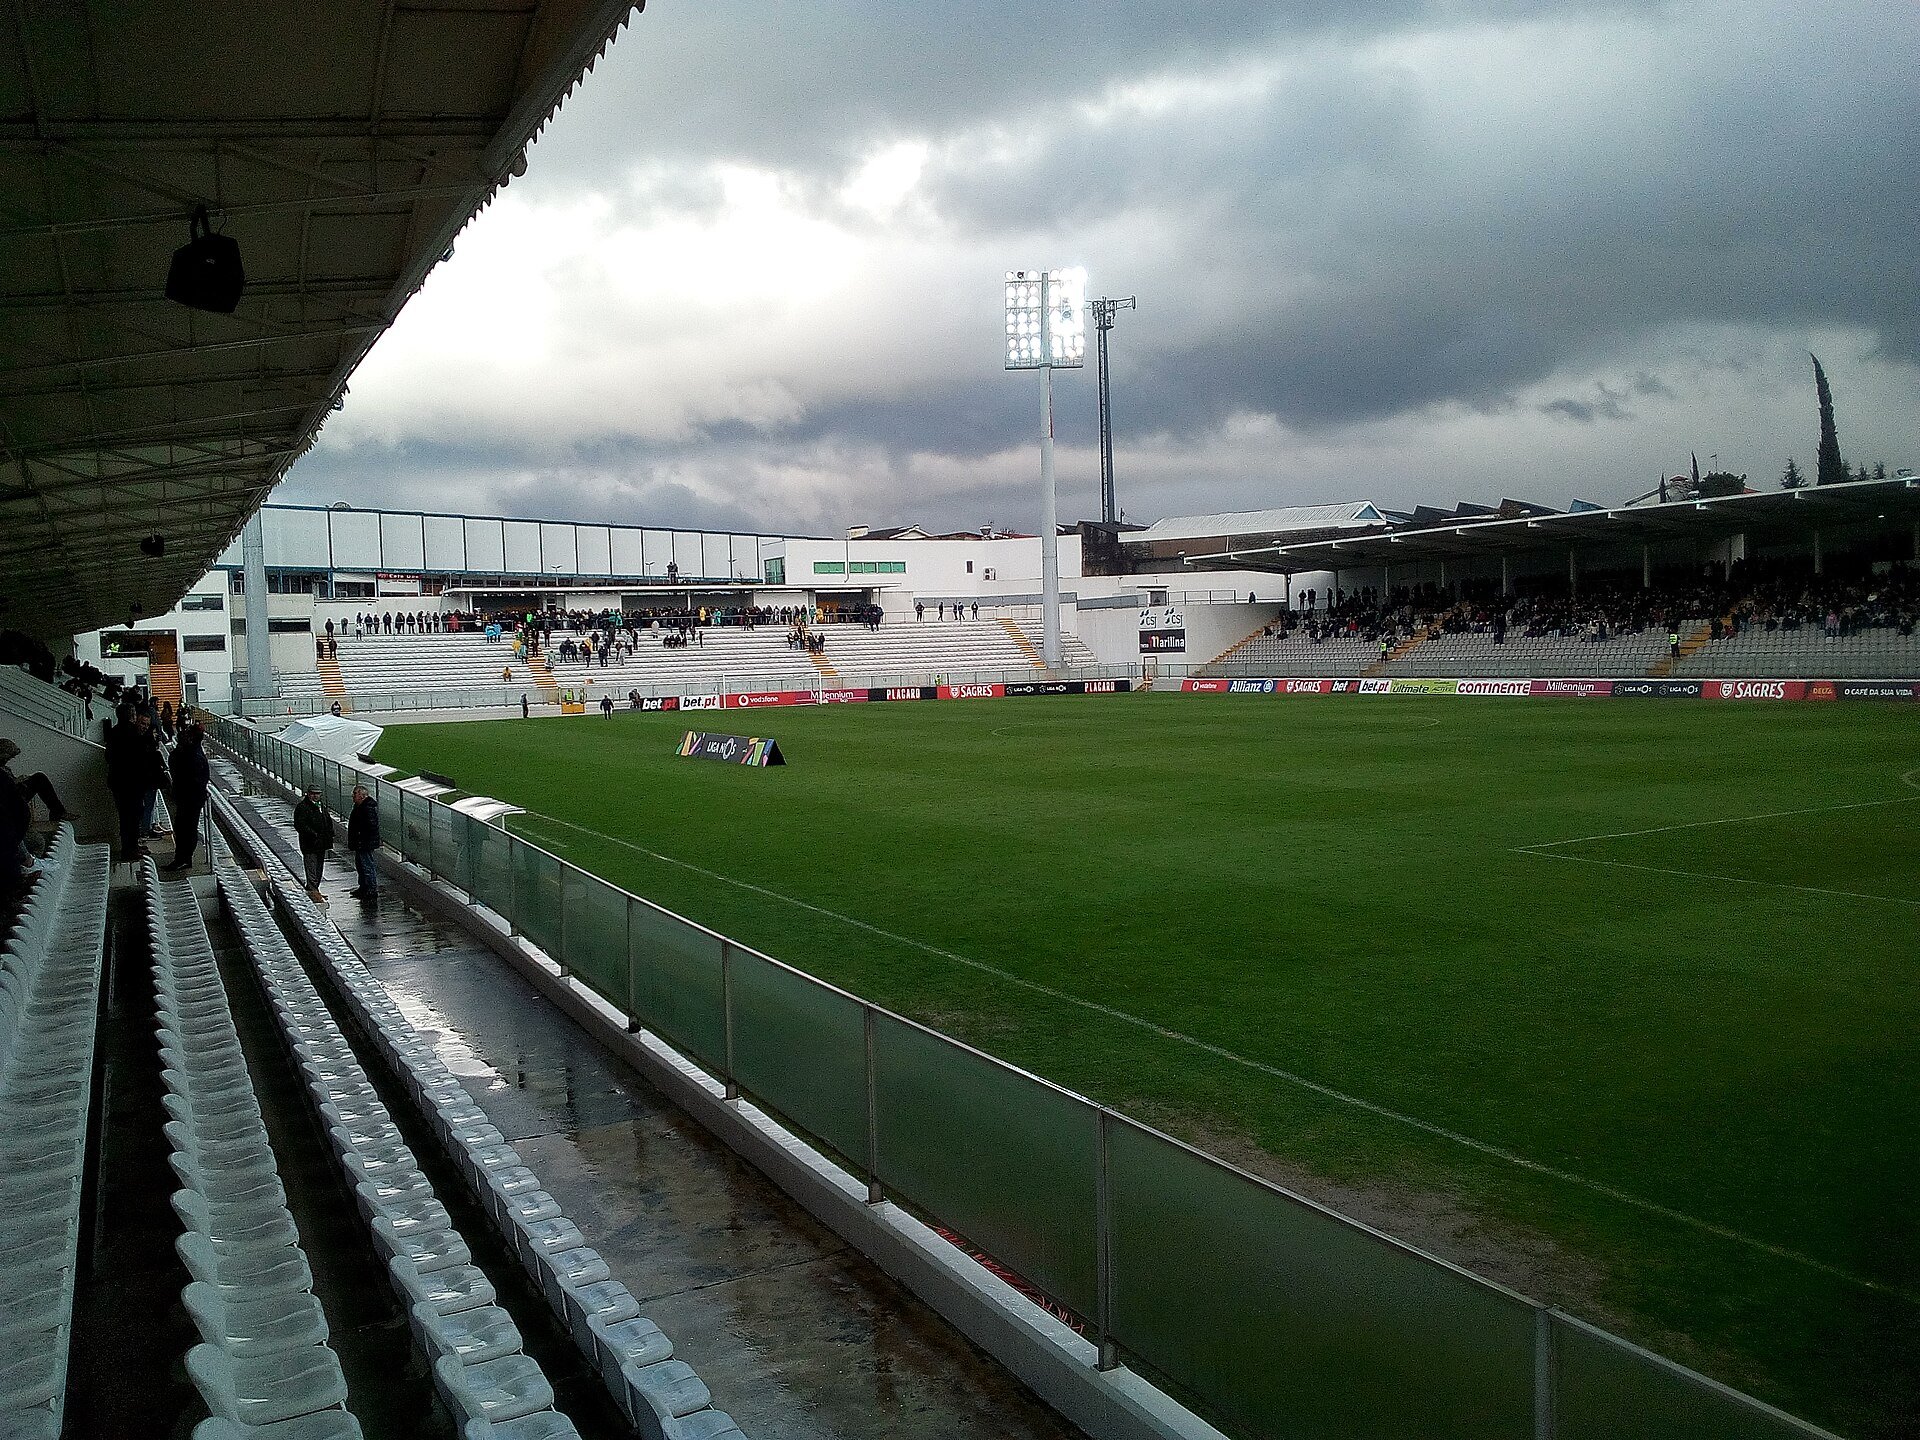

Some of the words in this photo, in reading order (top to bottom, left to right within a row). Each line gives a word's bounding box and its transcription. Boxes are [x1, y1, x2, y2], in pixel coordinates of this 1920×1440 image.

[960, 685, 993, 697] SAGRES
[1230, 680, 1262, 693] Allianz
[1294, 680, 1322, 693] SAGRES
[1361, 680, 1390, 694] bet.pt
[1393, 684, 1430, 694] ultimate
[1458, 682, 1531, 694] CONTINENTE
[1546, 681, 1595, 692] Millennium
[1735, 681, 1786, 699] SAGRES
[1850, 687, 1869, 696] CAFÉ
[1869, 688, 1879, 696] DA
[1880, 688, 1895, 696] SUA
[1895, 688, 1913, 696] VIDA
[683, 695, 716, 709] bet.pt
